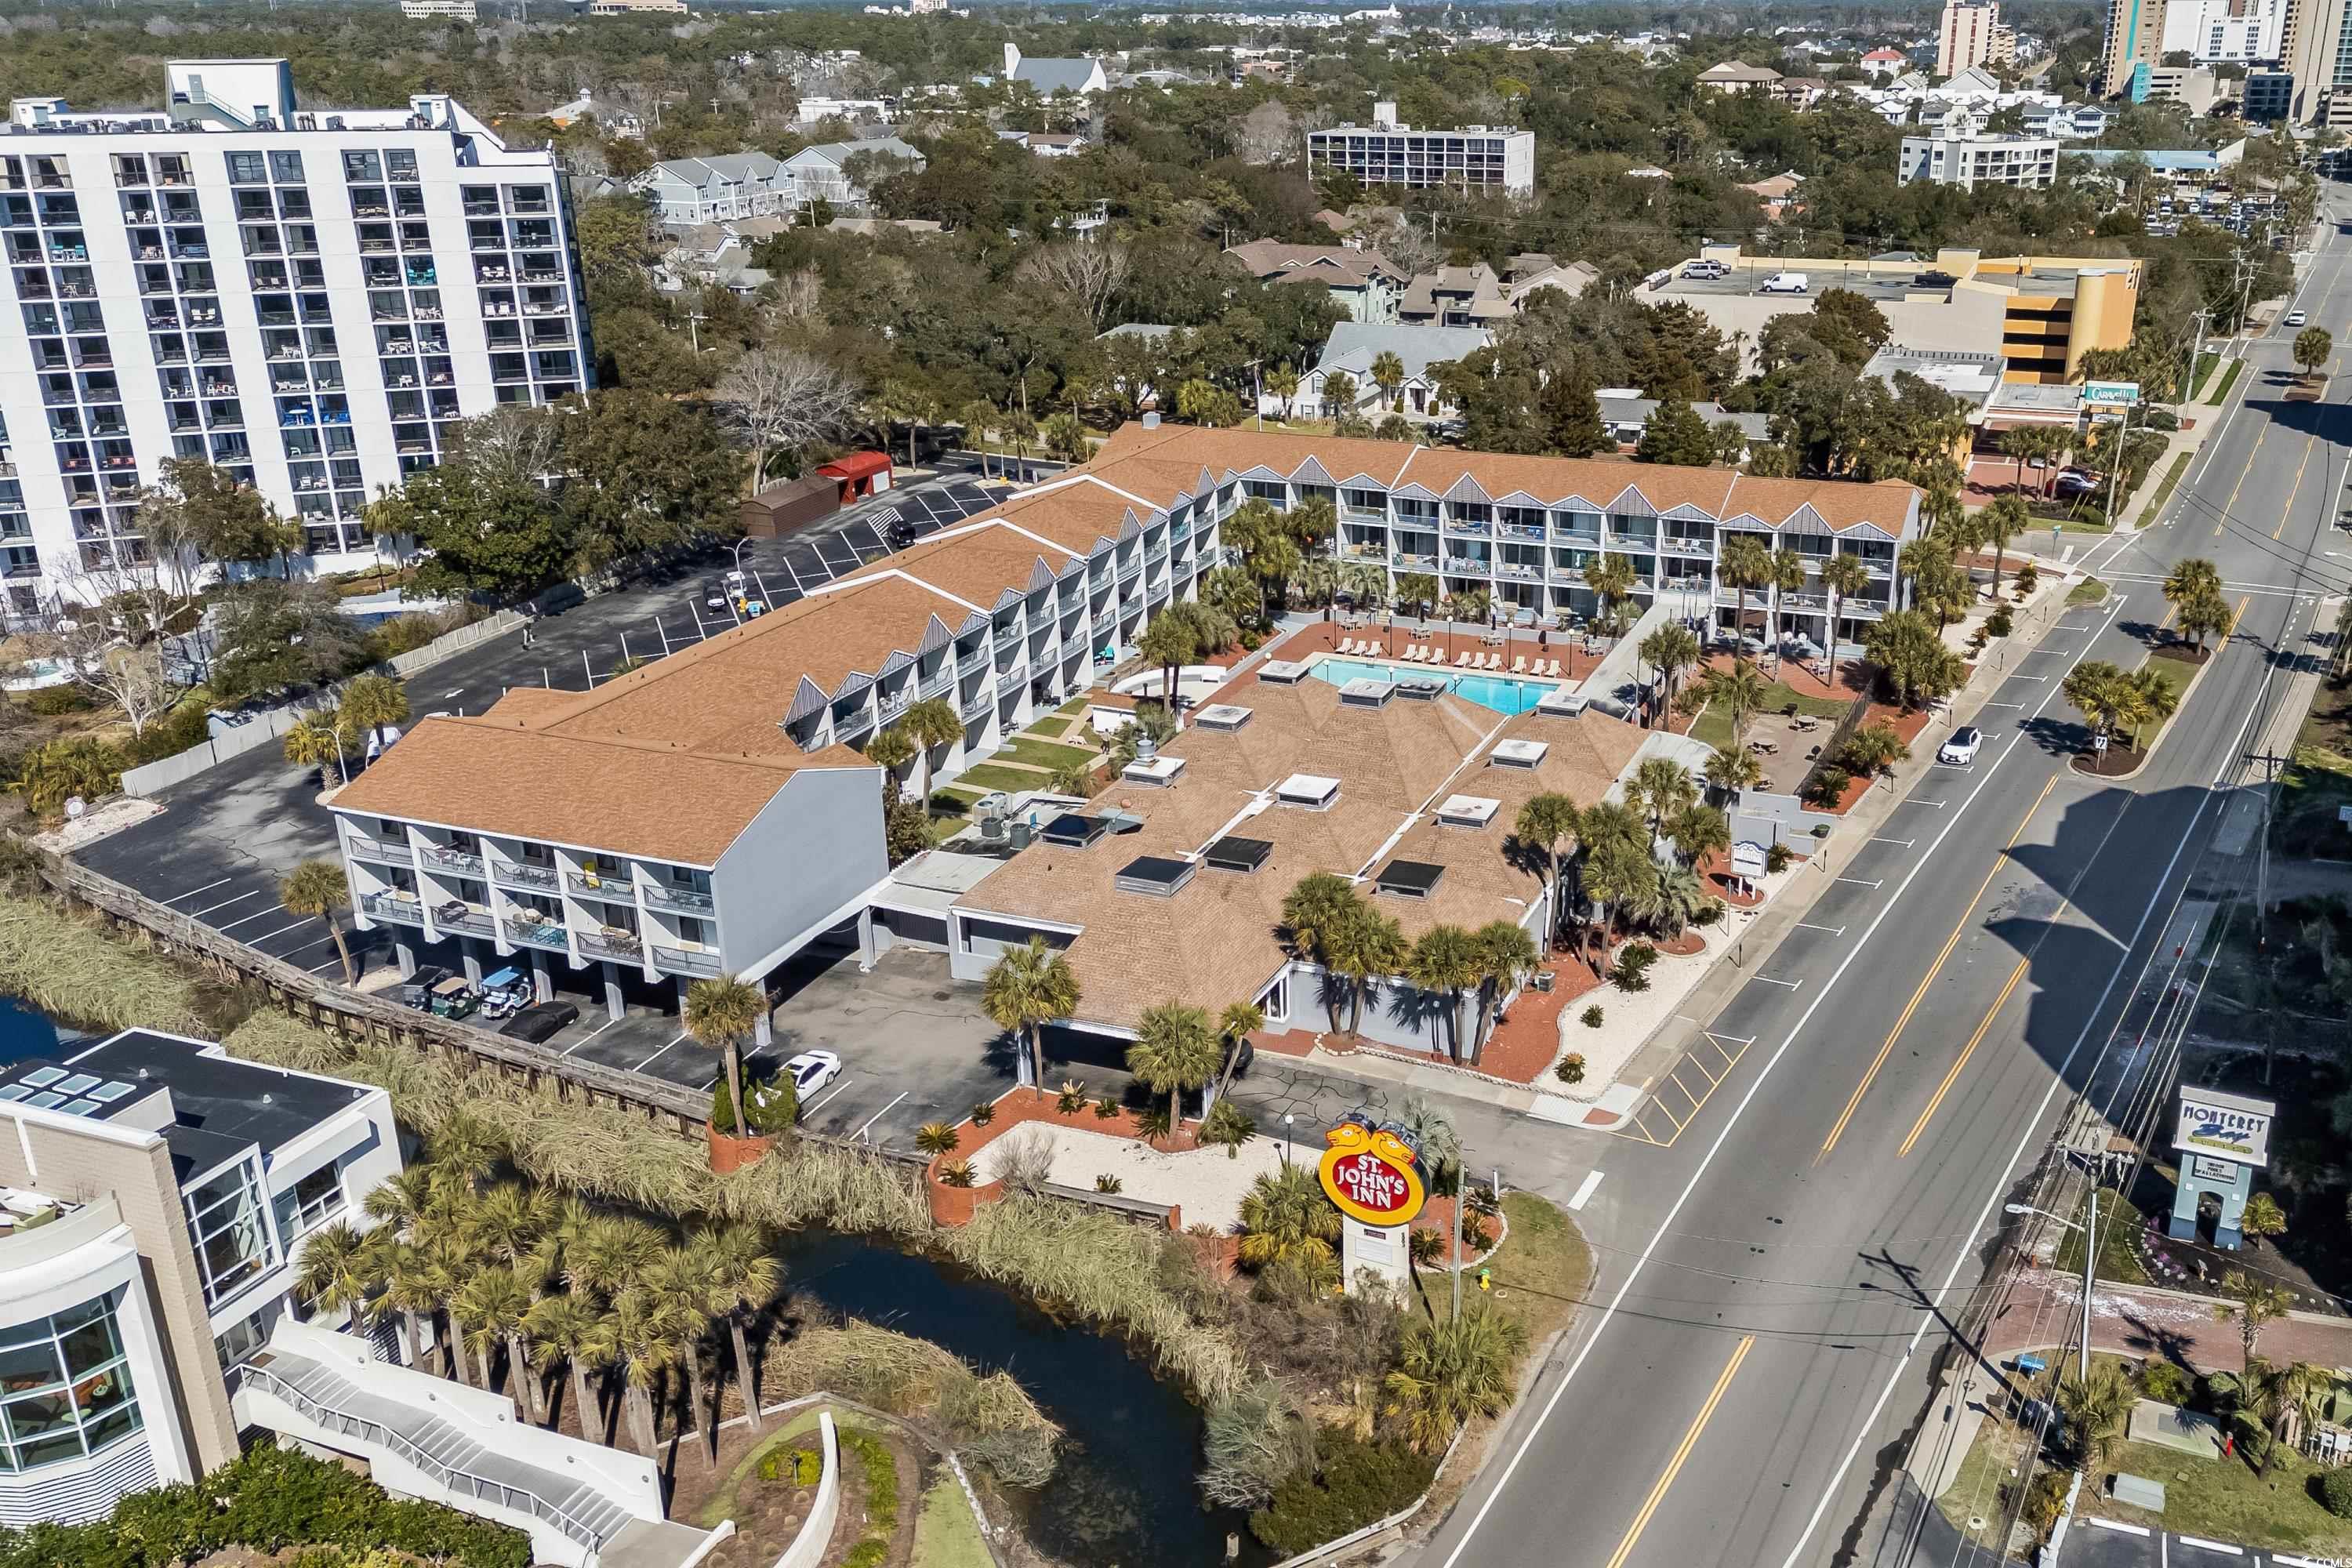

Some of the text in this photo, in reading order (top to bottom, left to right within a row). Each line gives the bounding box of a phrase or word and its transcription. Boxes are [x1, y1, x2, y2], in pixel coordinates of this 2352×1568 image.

[2183, 1105, 2265, 1132] MONTEREY
[1358, 1155, 1383, 1174] ST.
[1338, 1166, 1404, 1195] JOHN'S
[1352, 1185, 1391, 1209] INN
